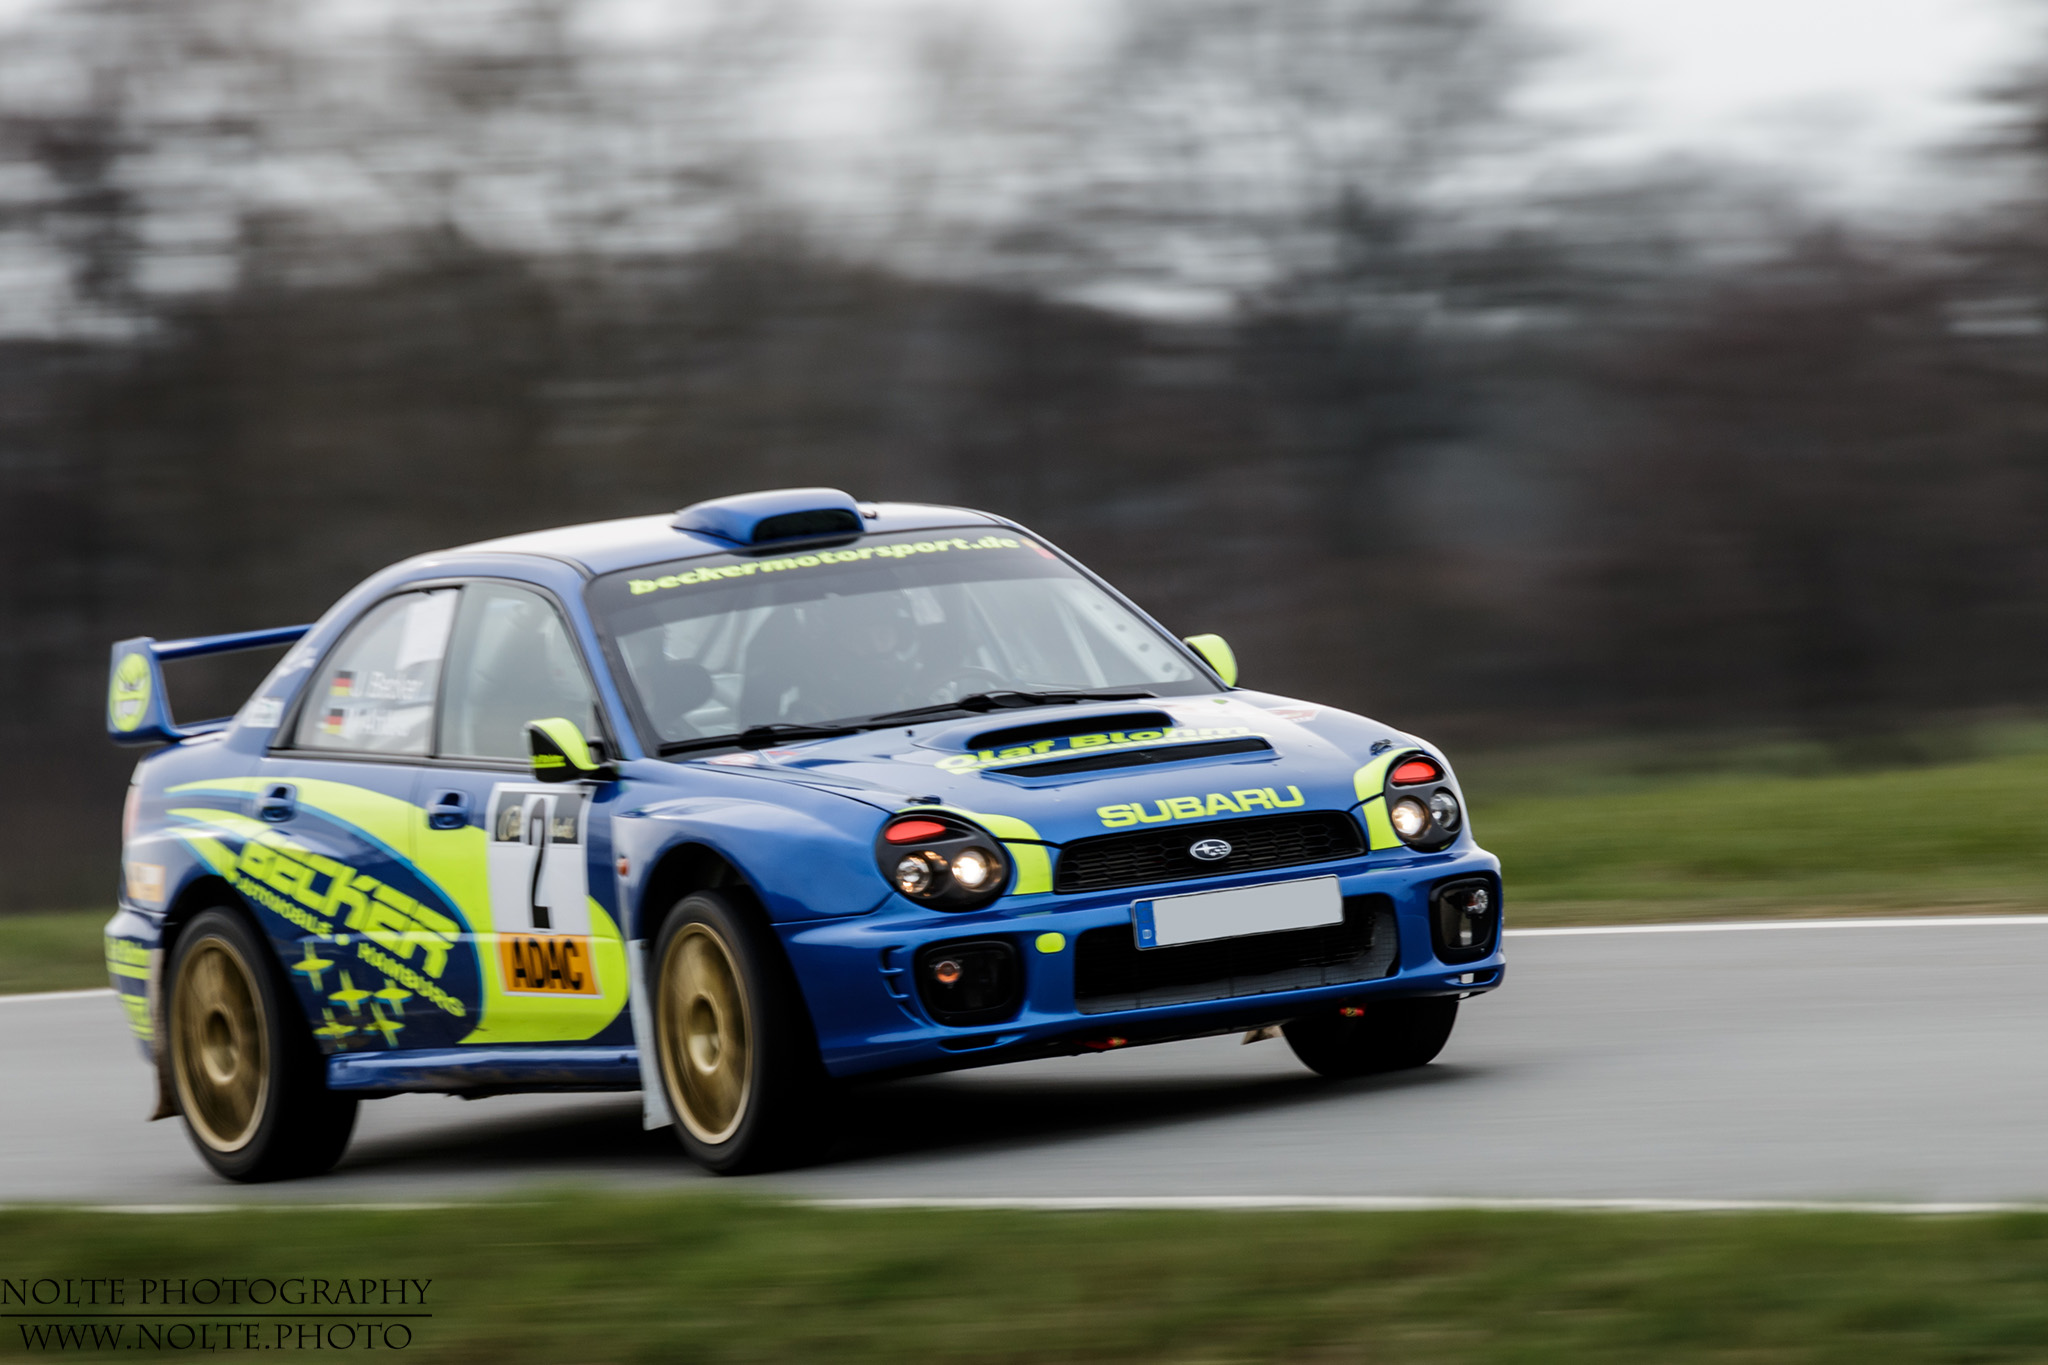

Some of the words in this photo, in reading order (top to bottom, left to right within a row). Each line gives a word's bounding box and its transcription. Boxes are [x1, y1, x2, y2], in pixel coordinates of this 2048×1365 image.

[628, 535, 1021, 595] beckermotorsport.de
[935, 740, 1056, 770] Olaf
[1069, 727, 1252, 748] Blohm
[1096, 785, 1305, 828] SUBARU
[528, 797, 552, 929] 2
[236, 832, 461, 978] BECKER
[513, 937, 584, 990] ADAC
